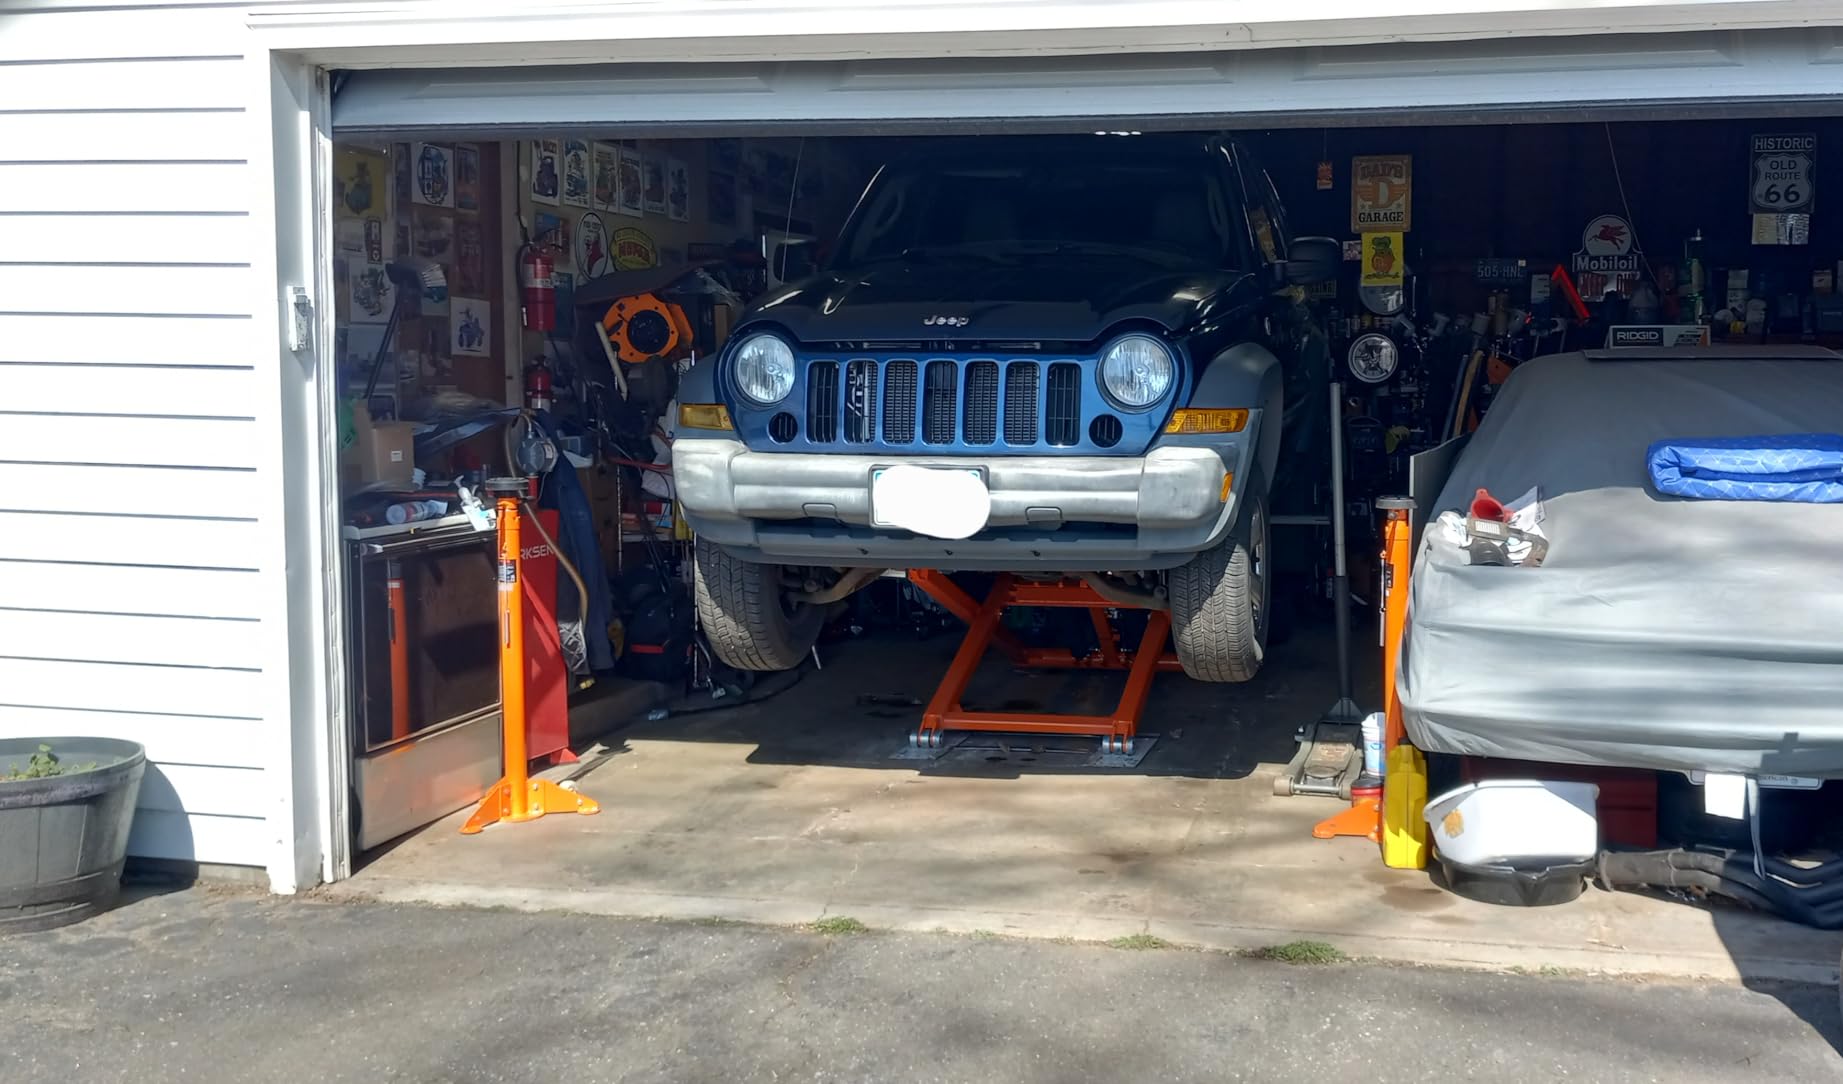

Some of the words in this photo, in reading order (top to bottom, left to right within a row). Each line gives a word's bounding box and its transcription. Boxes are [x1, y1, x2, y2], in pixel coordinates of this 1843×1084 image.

[1754, 137, 1814, 150] HISTORIC
[1769, 160, 1797, 170] OLD
[1764, 171, 1801, 181] ROUTE
[1764, 183, 1801, 204] 66
[1358, 211, 1404, 224] GARAGE
[1576, 255, 1638, 271] Mobiloil
[923, 314, 970, 327] Jeep
[1616, 331, 1660, 341] RIDGID
